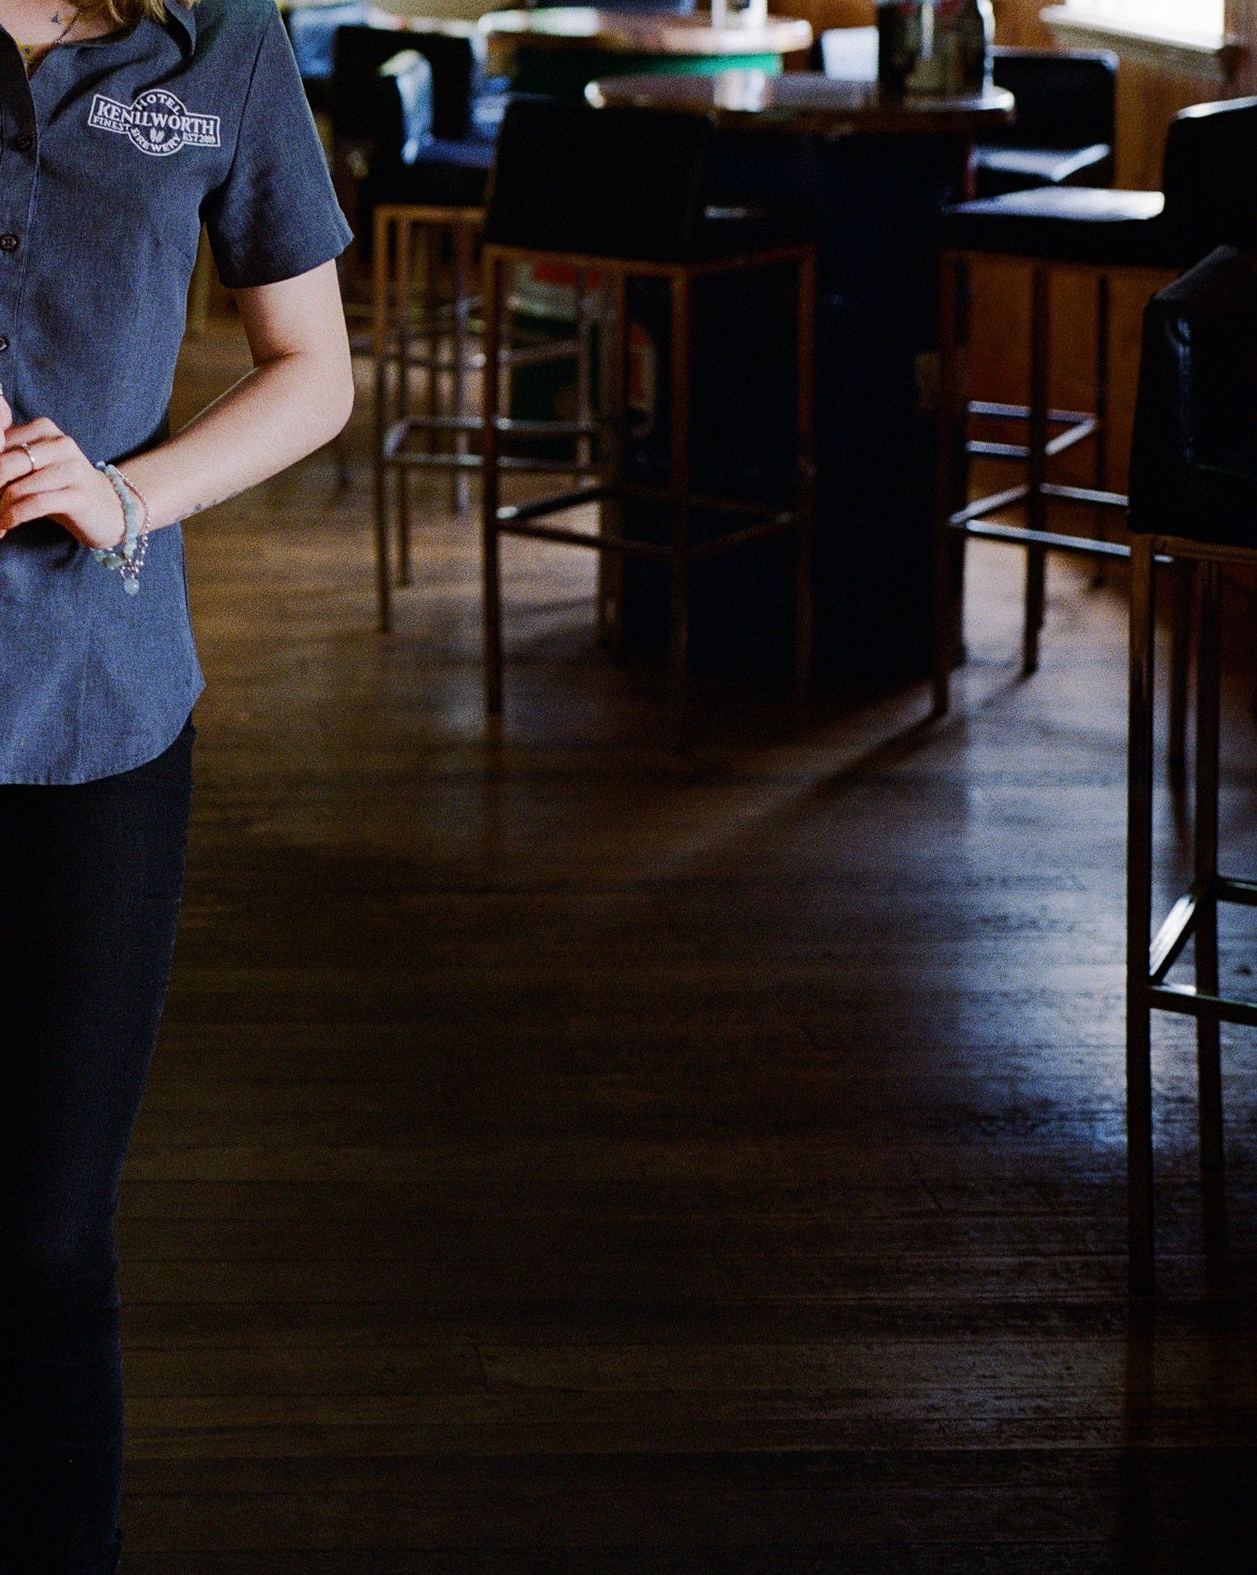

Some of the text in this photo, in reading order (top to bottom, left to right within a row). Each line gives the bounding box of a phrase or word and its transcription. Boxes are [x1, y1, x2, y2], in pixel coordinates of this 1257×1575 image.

[135, 93, 181, 115] HOTEL
[93, 115, 131, 131] FINEST
[97, 100, 215, 135] KENILWORTH
[130, 127, 181, 152] BREWERY
